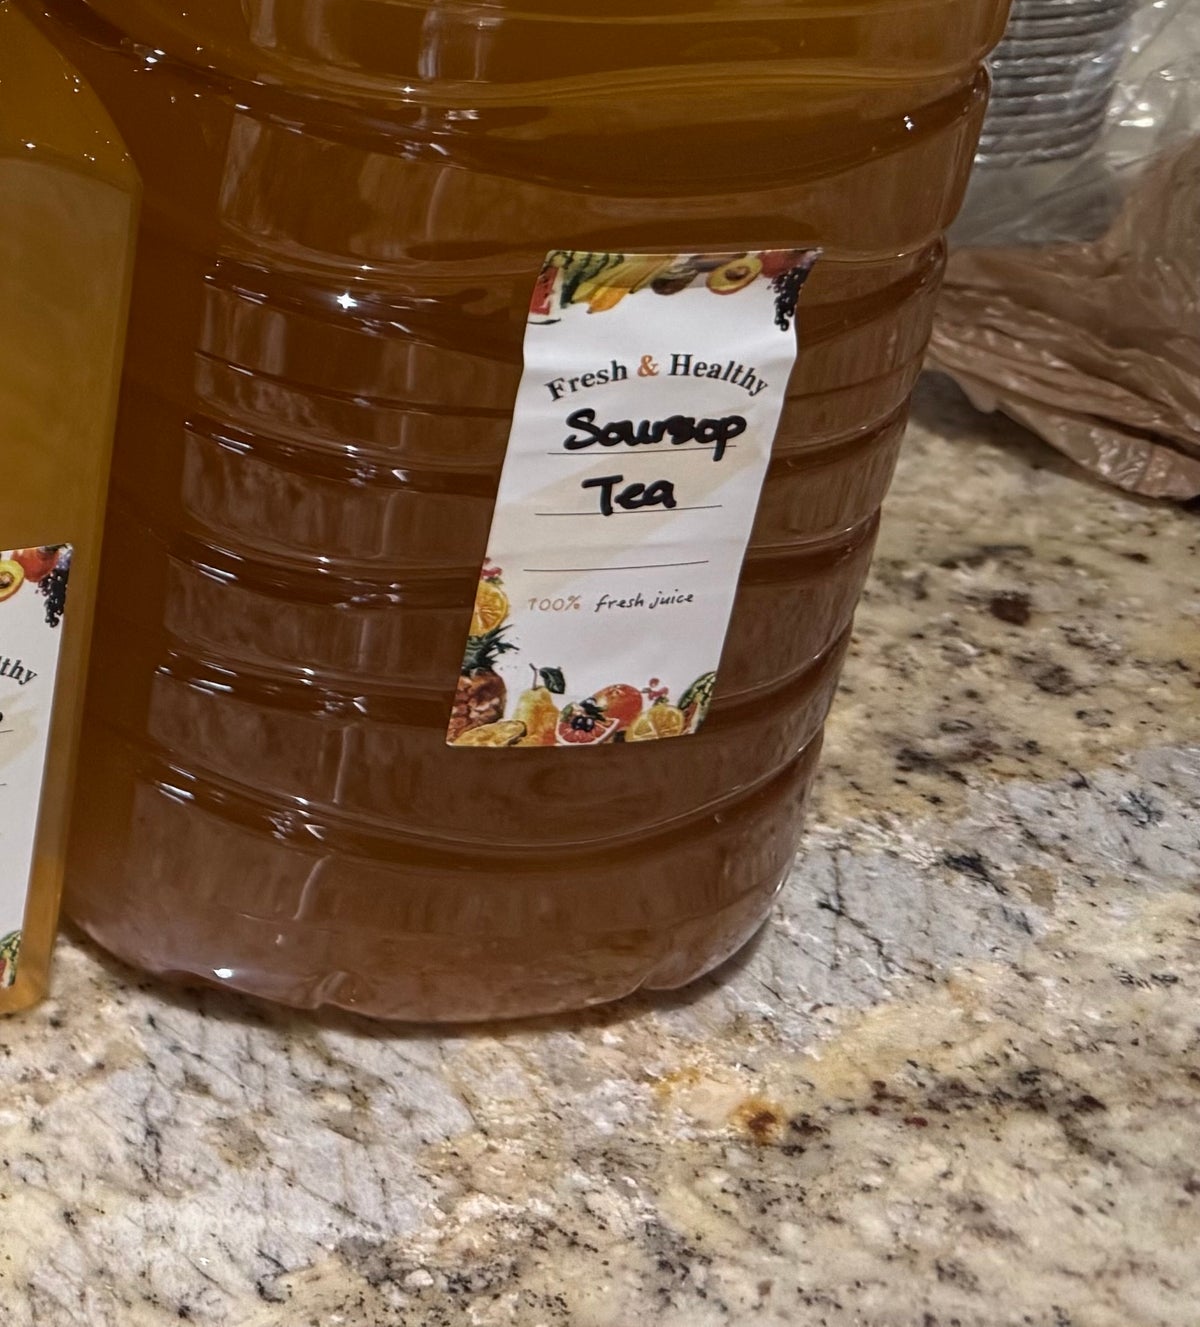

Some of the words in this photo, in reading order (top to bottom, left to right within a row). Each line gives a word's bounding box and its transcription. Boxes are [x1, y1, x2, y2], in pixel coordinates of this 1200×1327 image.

[544, 359, 628, 402] Fresh
[636, 354, 659, 377] &
[668, 353, 768, 397] Healthy
[563, 408, 747, 462] Soursop
[581, 474, 677, 517] Tea
[528, 594, 581, 612] 100%
[594, 592, 645, 613] fresh
[648, 588, 694, 610] juice
[0, 656, 38, 685] thy
